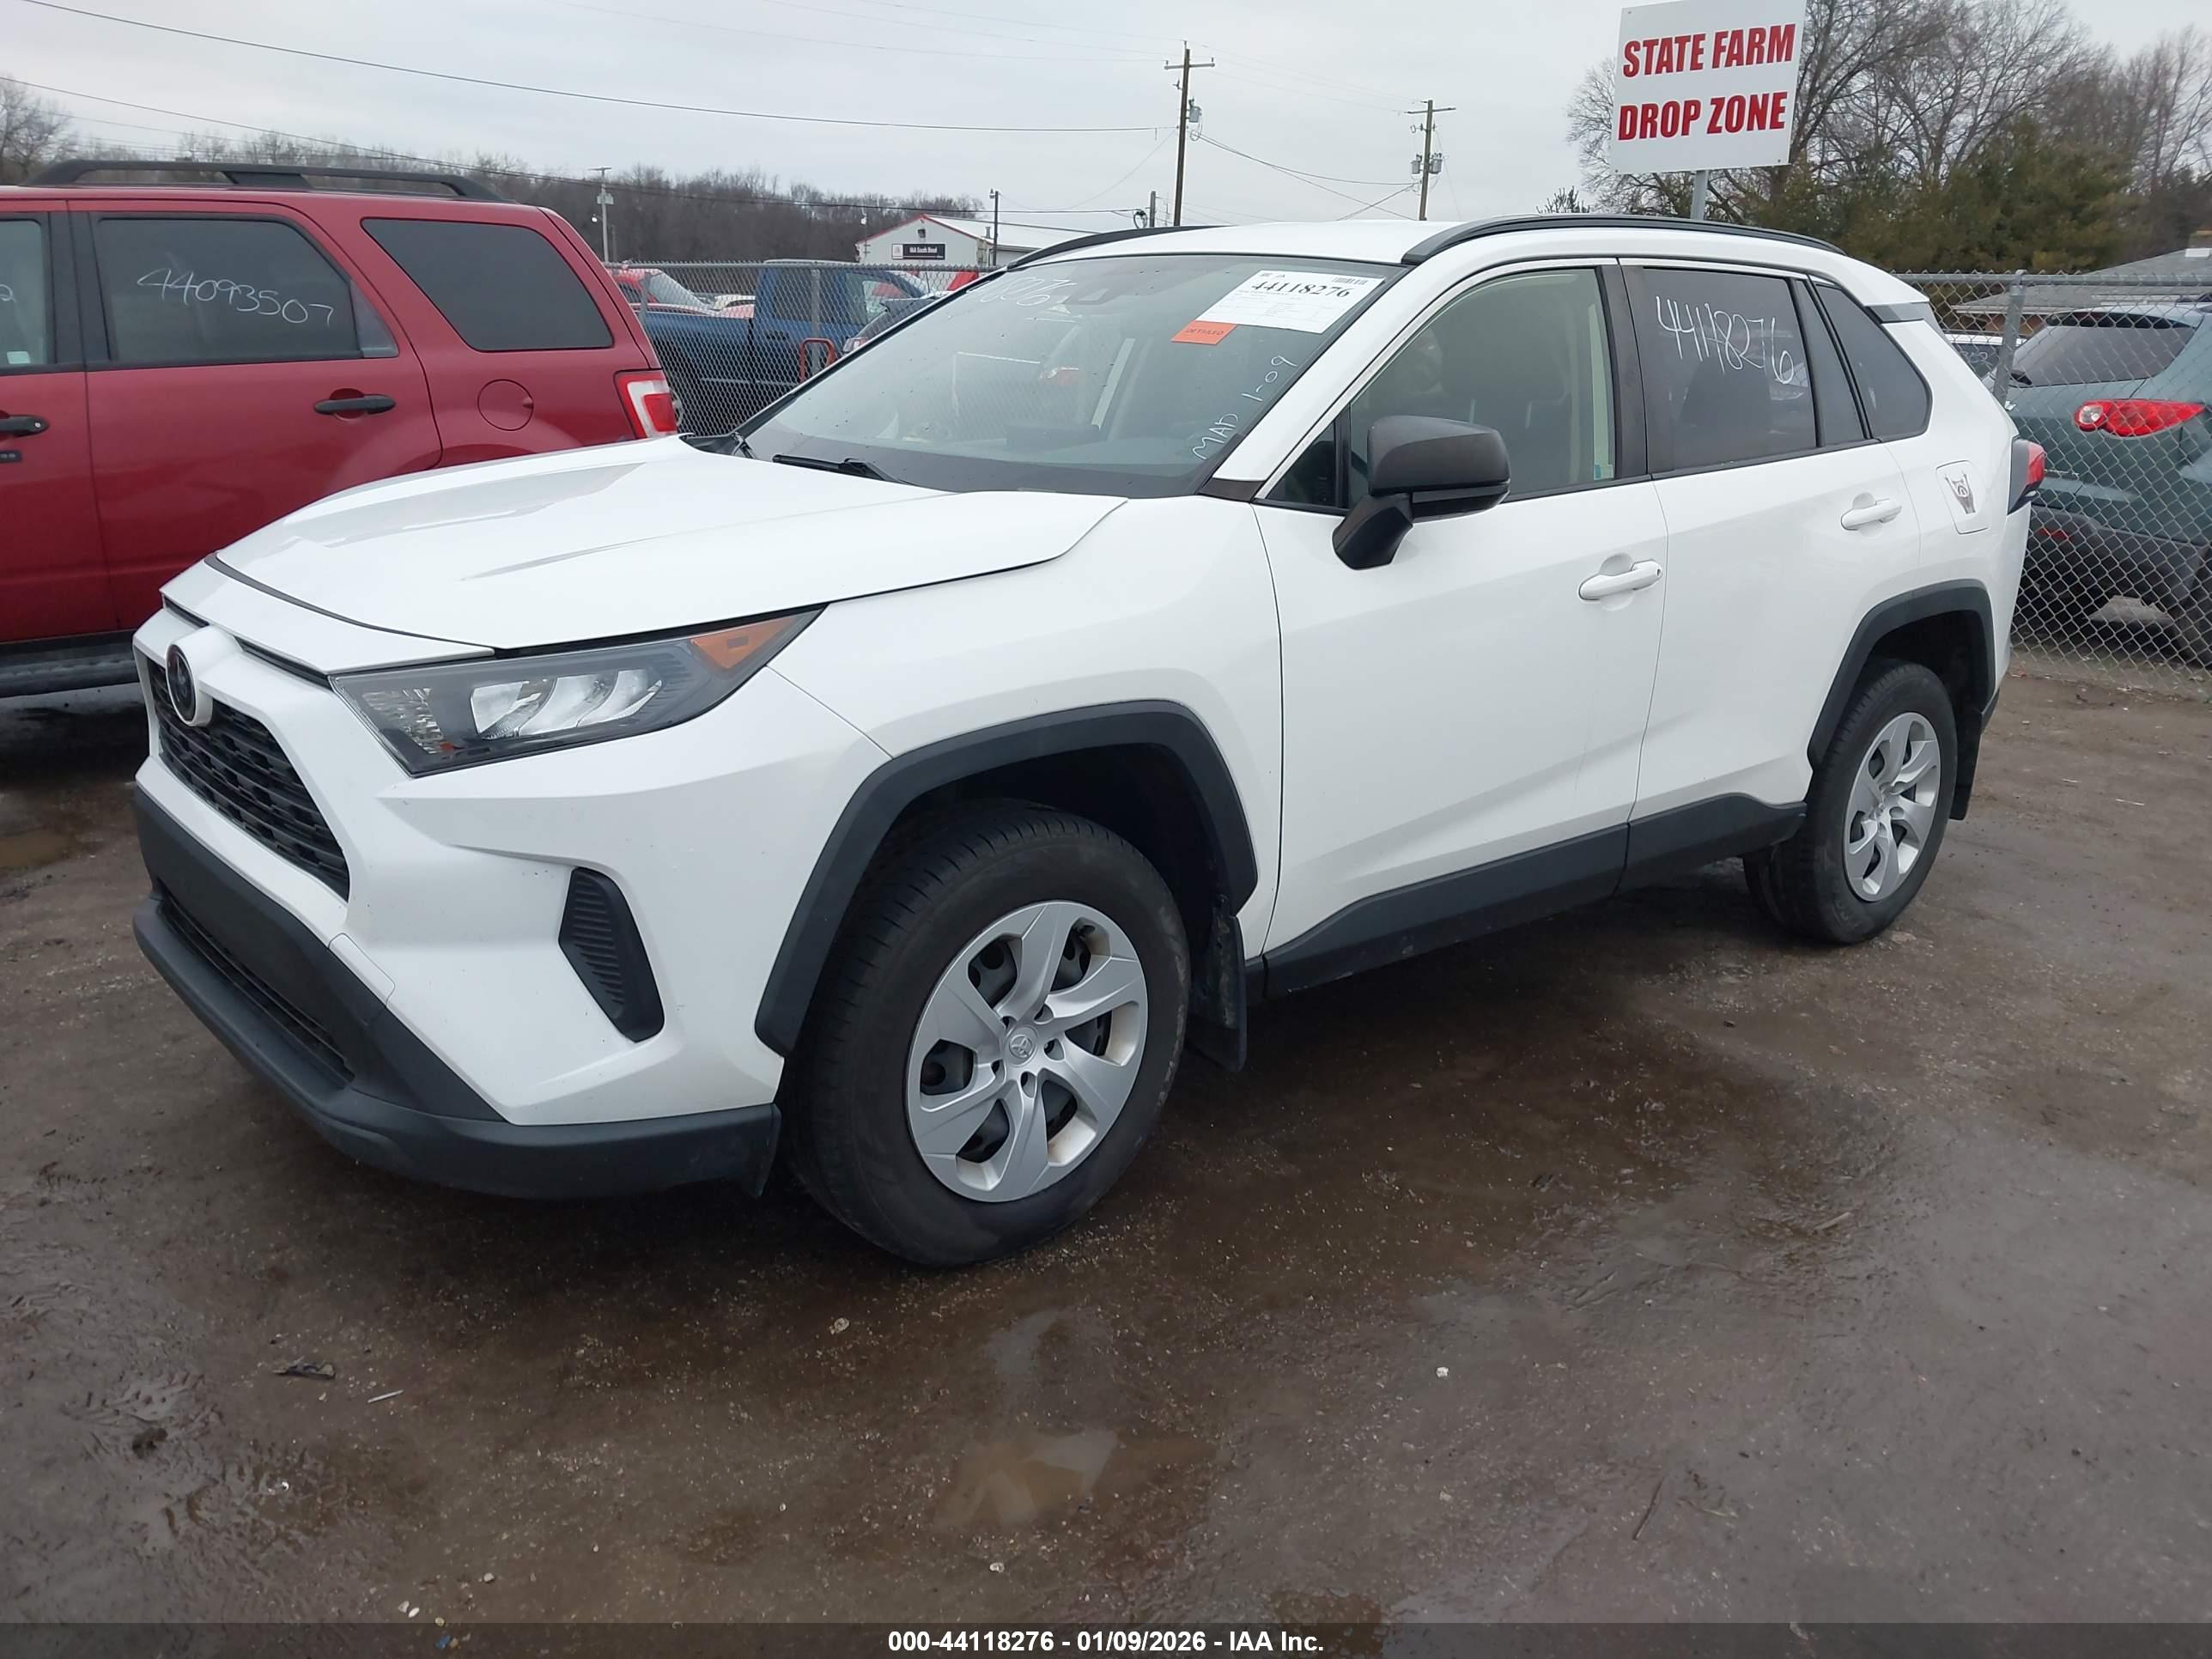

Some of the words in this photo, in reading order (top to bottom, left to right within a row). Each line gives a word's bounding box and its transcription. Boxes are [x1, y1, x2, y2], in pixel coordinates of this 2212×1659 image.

[1623, 33, 1706, 77] STATE
[1711, 24, 1796, 69] FARM
[1618, 99, 1702, 141] DROP
[1706, 91, 1788, 134] ZONE
[137, 268, 334, 327] 44093507
[1251, 281, 1354, 298] 44118276
[1656, 295, 1794, 385] 44118276
[1240, 356, 1297, 402] 1-09
